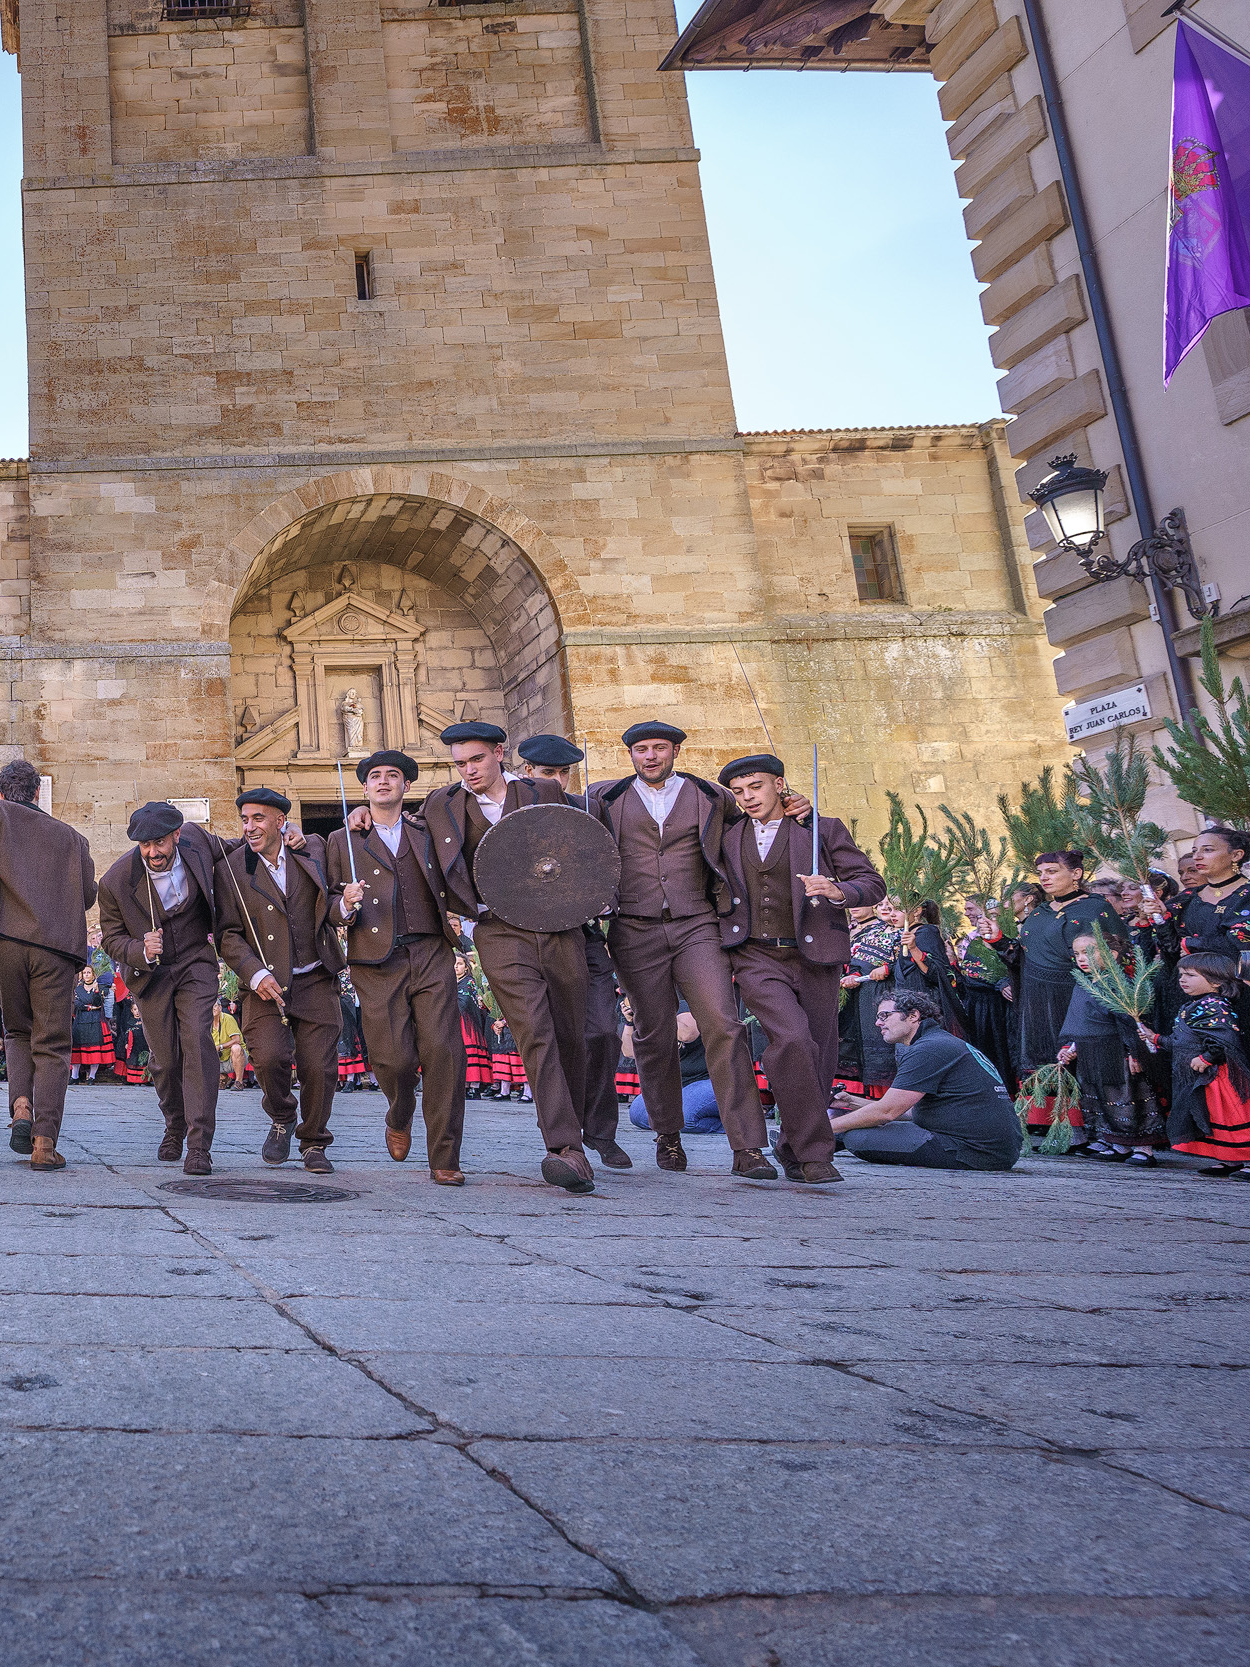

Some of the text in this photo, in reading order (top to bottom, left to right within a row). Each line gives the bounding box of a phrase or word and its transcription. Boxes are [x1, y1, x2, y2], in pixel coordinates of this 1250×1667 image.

[1090, 702, 1117, 715] PLAZA
[1069, 725, 1083, 734] REY
[1087, 718, 1105, 729] JUAN
[1107, 707, 1140, 722] CARLOS
